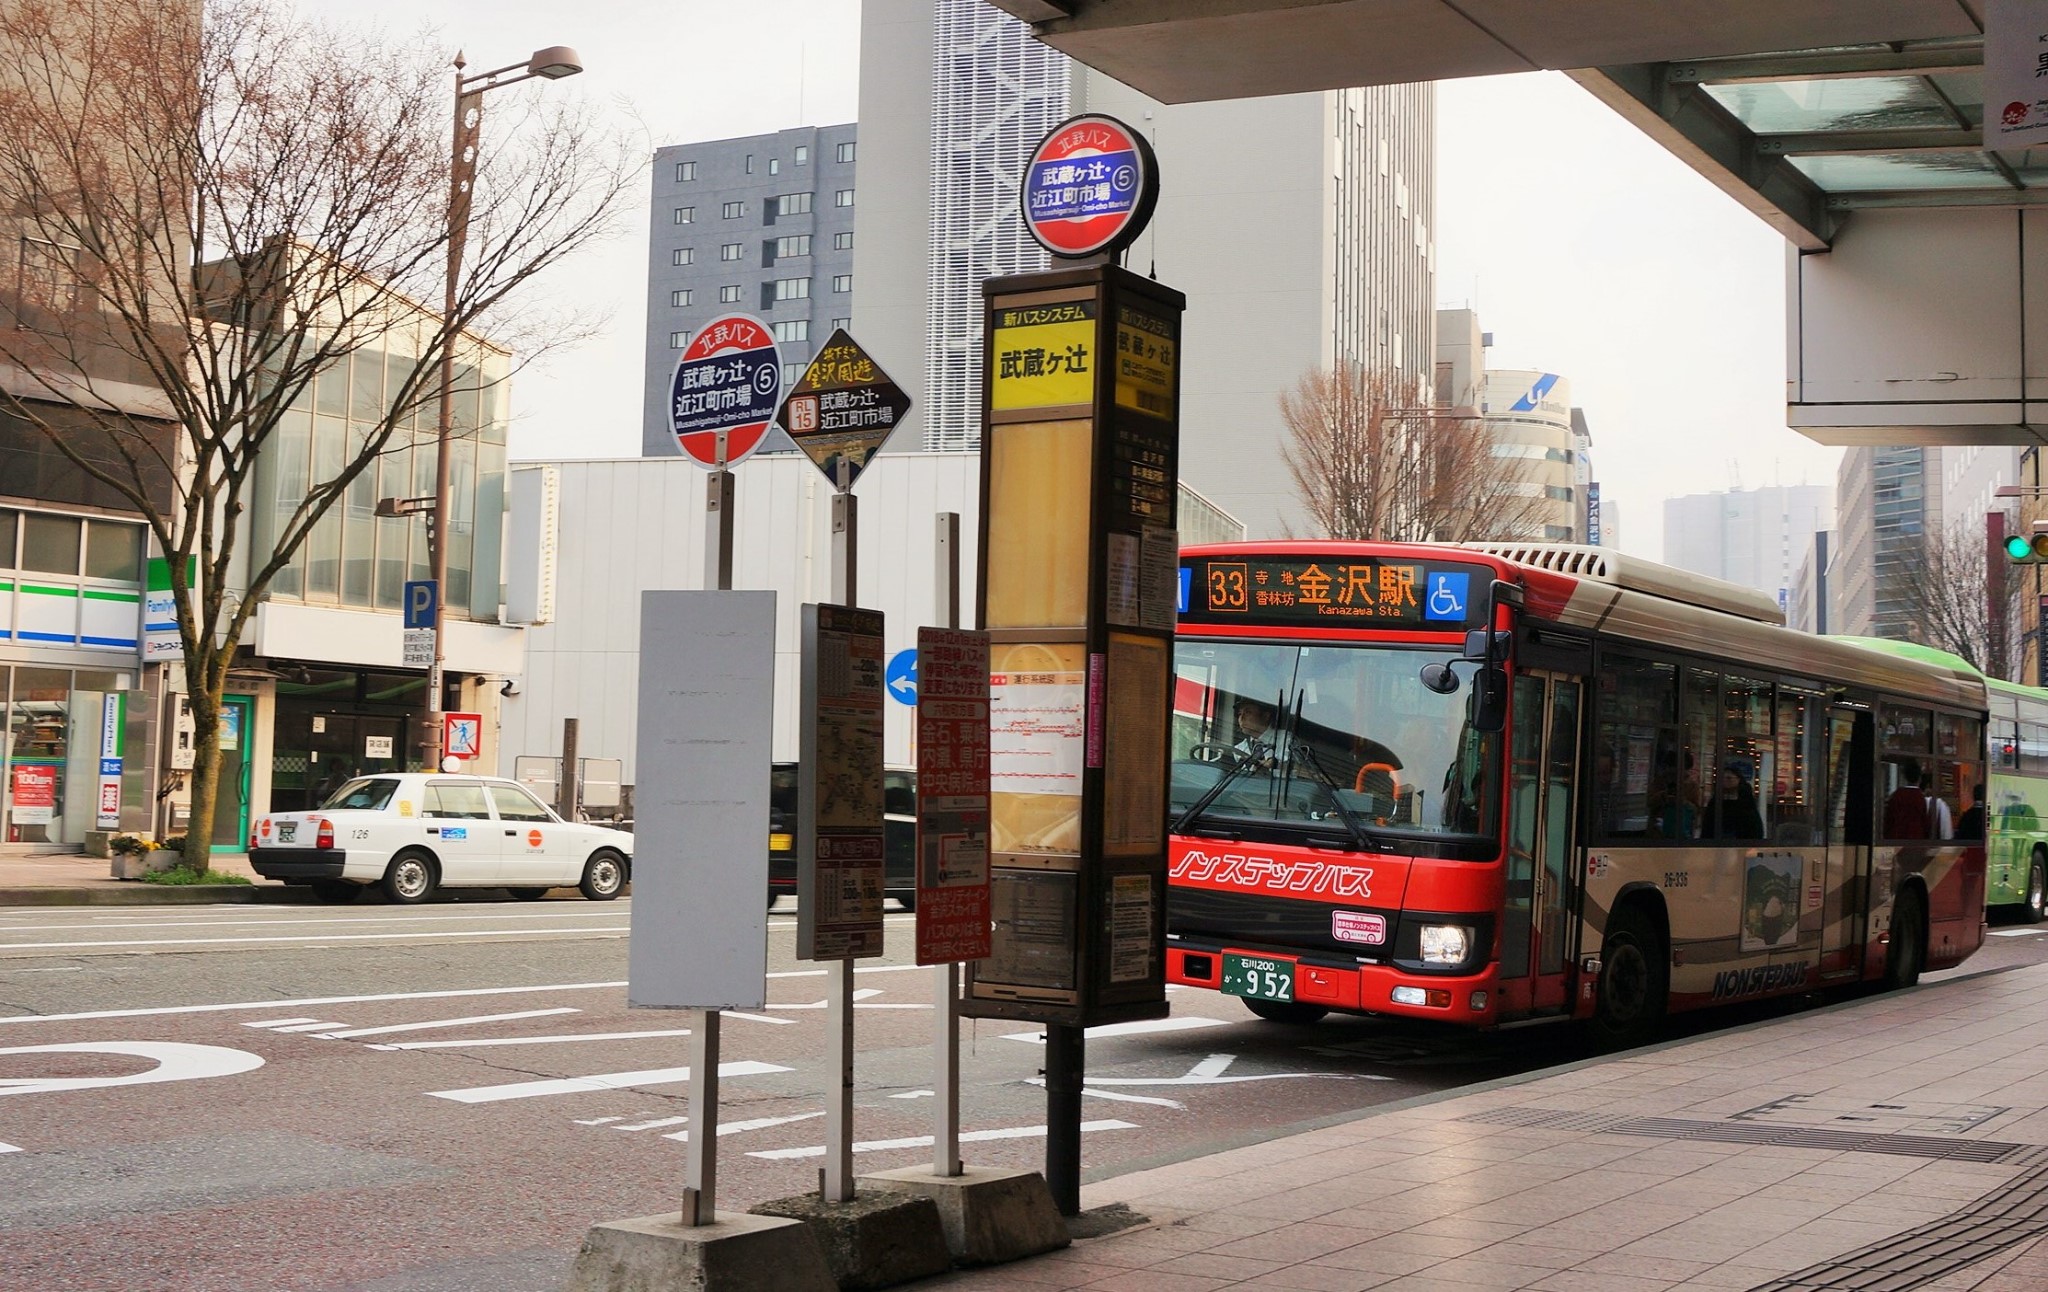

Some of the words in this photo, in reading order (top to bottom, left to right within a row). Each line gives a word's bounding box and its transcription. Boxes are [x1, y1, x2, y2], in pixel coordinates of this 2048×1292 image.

[1058, 130, 1111, 154] 北鉄バス
[1030, 183, 1111, 208] 近江町市場
[1109, 200, 1130, 208] Market
[1004, 309, 1086, 327] 新バスシステム
[699, 324, 756, 355] 北鉄バス
[806, 360, 874, 389] 金沢周遊
[676, 385, 752, 417] 近江町市場
[751, 408, 773, 416] Market
[797, 402, 811, 414] RL
[796, 414, 812, 428] 15
[821, 407, 894, 429] 近江町市場
[1211, 570, 1244, 605] 33
[1297, 564, 1417, 607] 金沢駅
[147, 599, 177, 614] Family
[412, 586, 431, 623] P
[1256, 591, 1295, 606] 香林坊
[1318, 605, 1372, 616] Kanazawa
[1379, 606, 1404, 617] Sta.
[352, 830, 369, 839] 126
[1169, 851, 1374, 898] ノンステップバス
